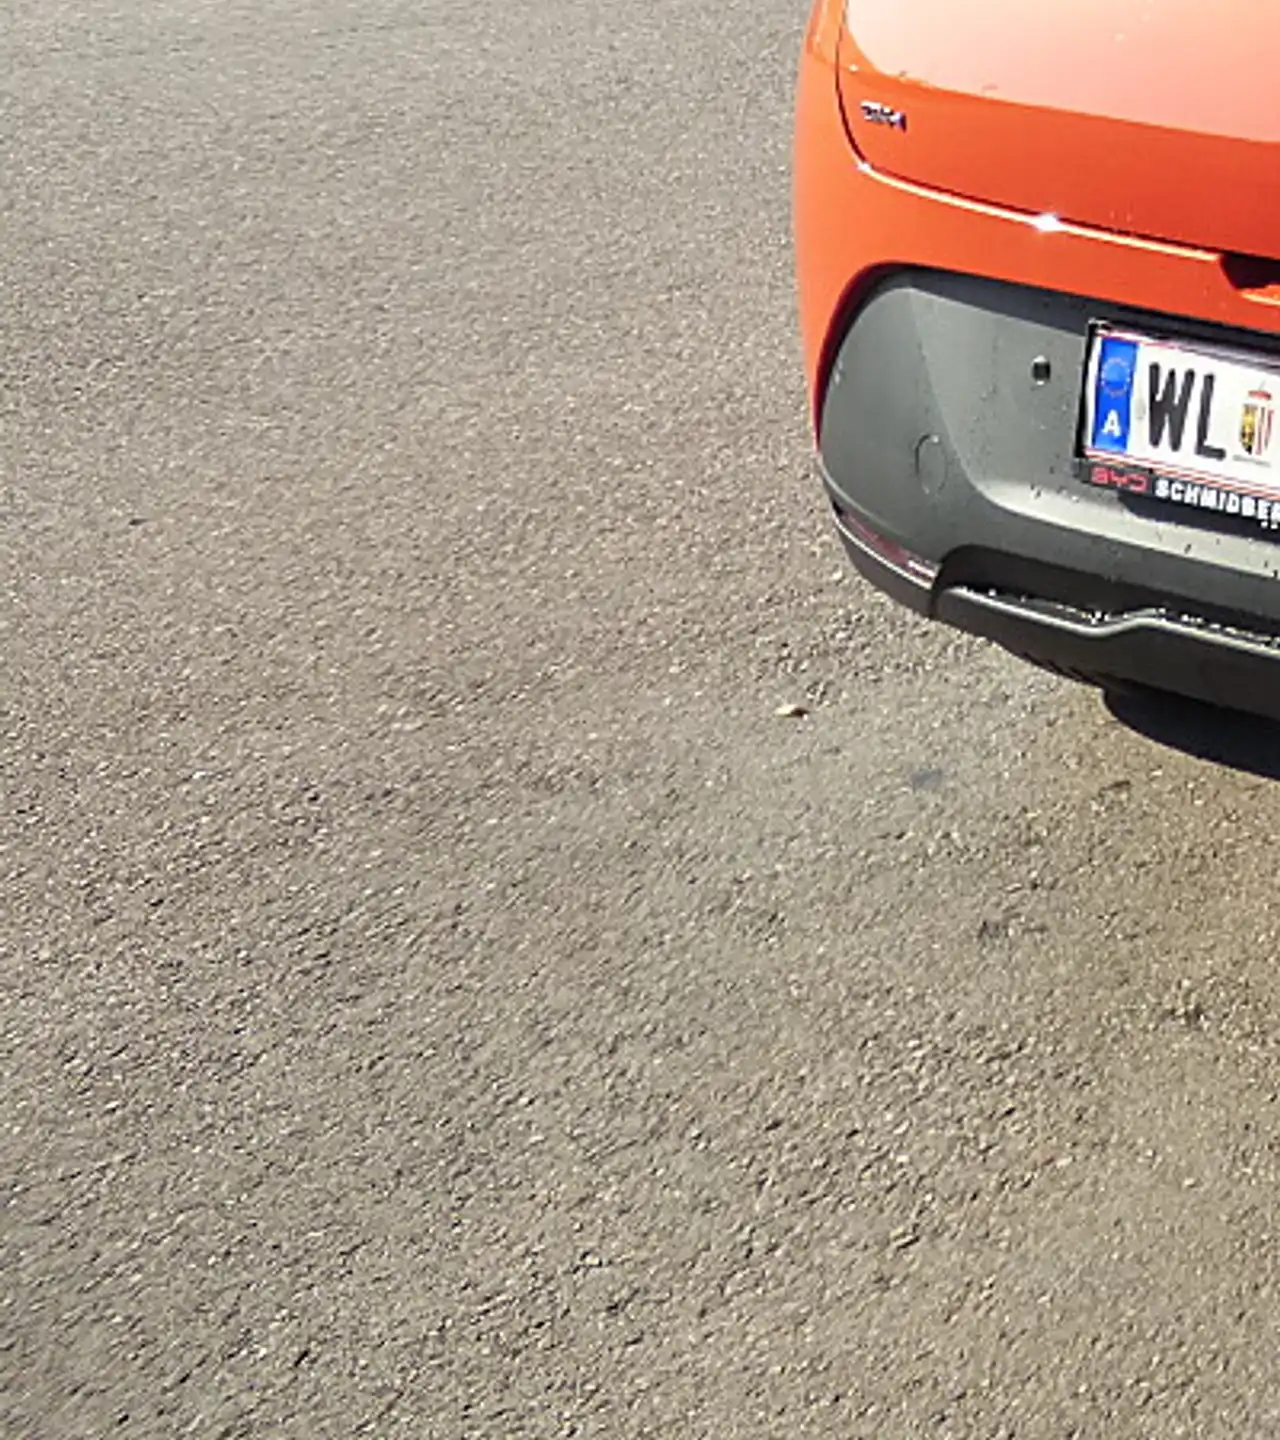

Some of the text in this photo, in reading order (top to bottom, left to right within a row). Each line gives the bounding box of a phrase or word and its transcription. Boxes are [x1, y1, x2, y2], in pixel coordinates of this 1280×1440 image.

[1101, 408, 1122, 438] A
[1147, 362, 1227, 461] WL
[1091, 466, 1148, 493] BYD
